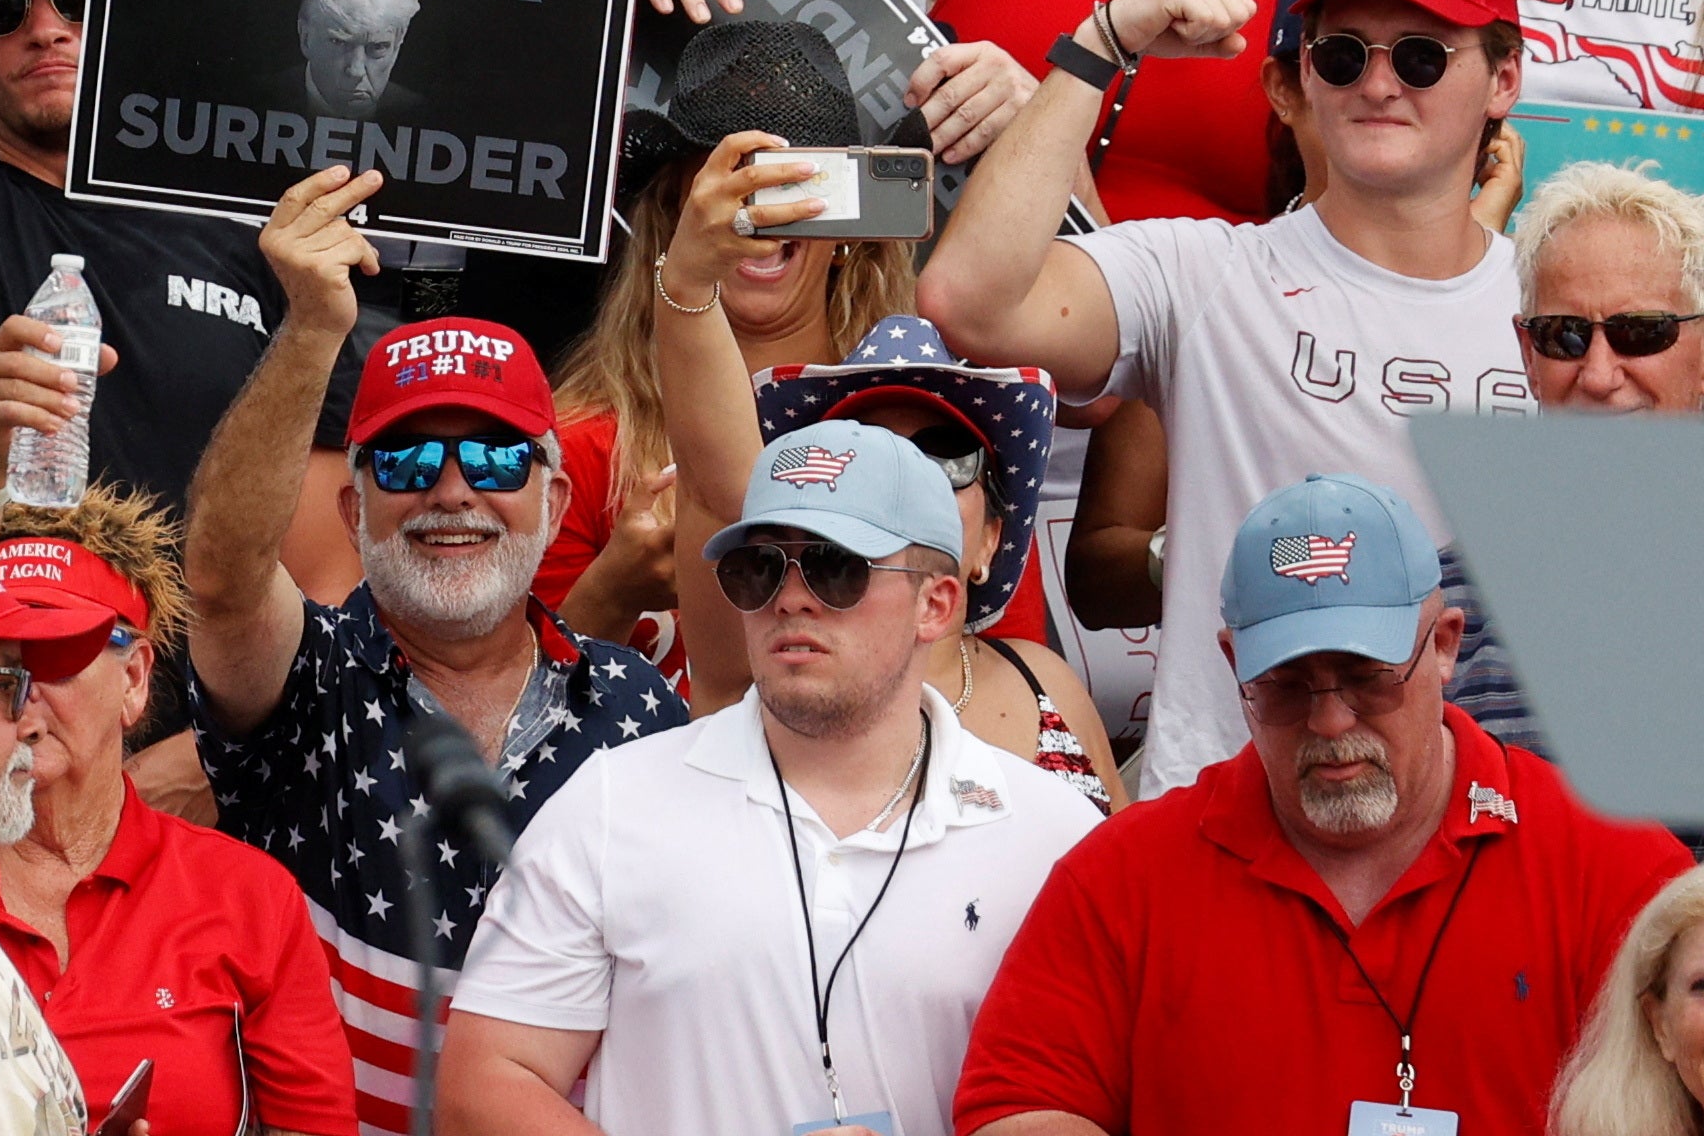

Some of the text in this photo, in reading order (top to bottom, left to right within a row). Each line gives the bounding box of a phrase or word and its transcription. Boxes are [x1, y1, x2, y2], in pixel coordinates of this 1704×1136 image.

[114, 91, 569, 201] SURRENDER
[167, 274, 269, 336] NRA
[386, 329, 515, 368] TRUMP
[395, 354, 504, 389] #1 #1 #1
[1290, 330, 1542, 417] USA
[9, 562, 63, 582] AGAIN
